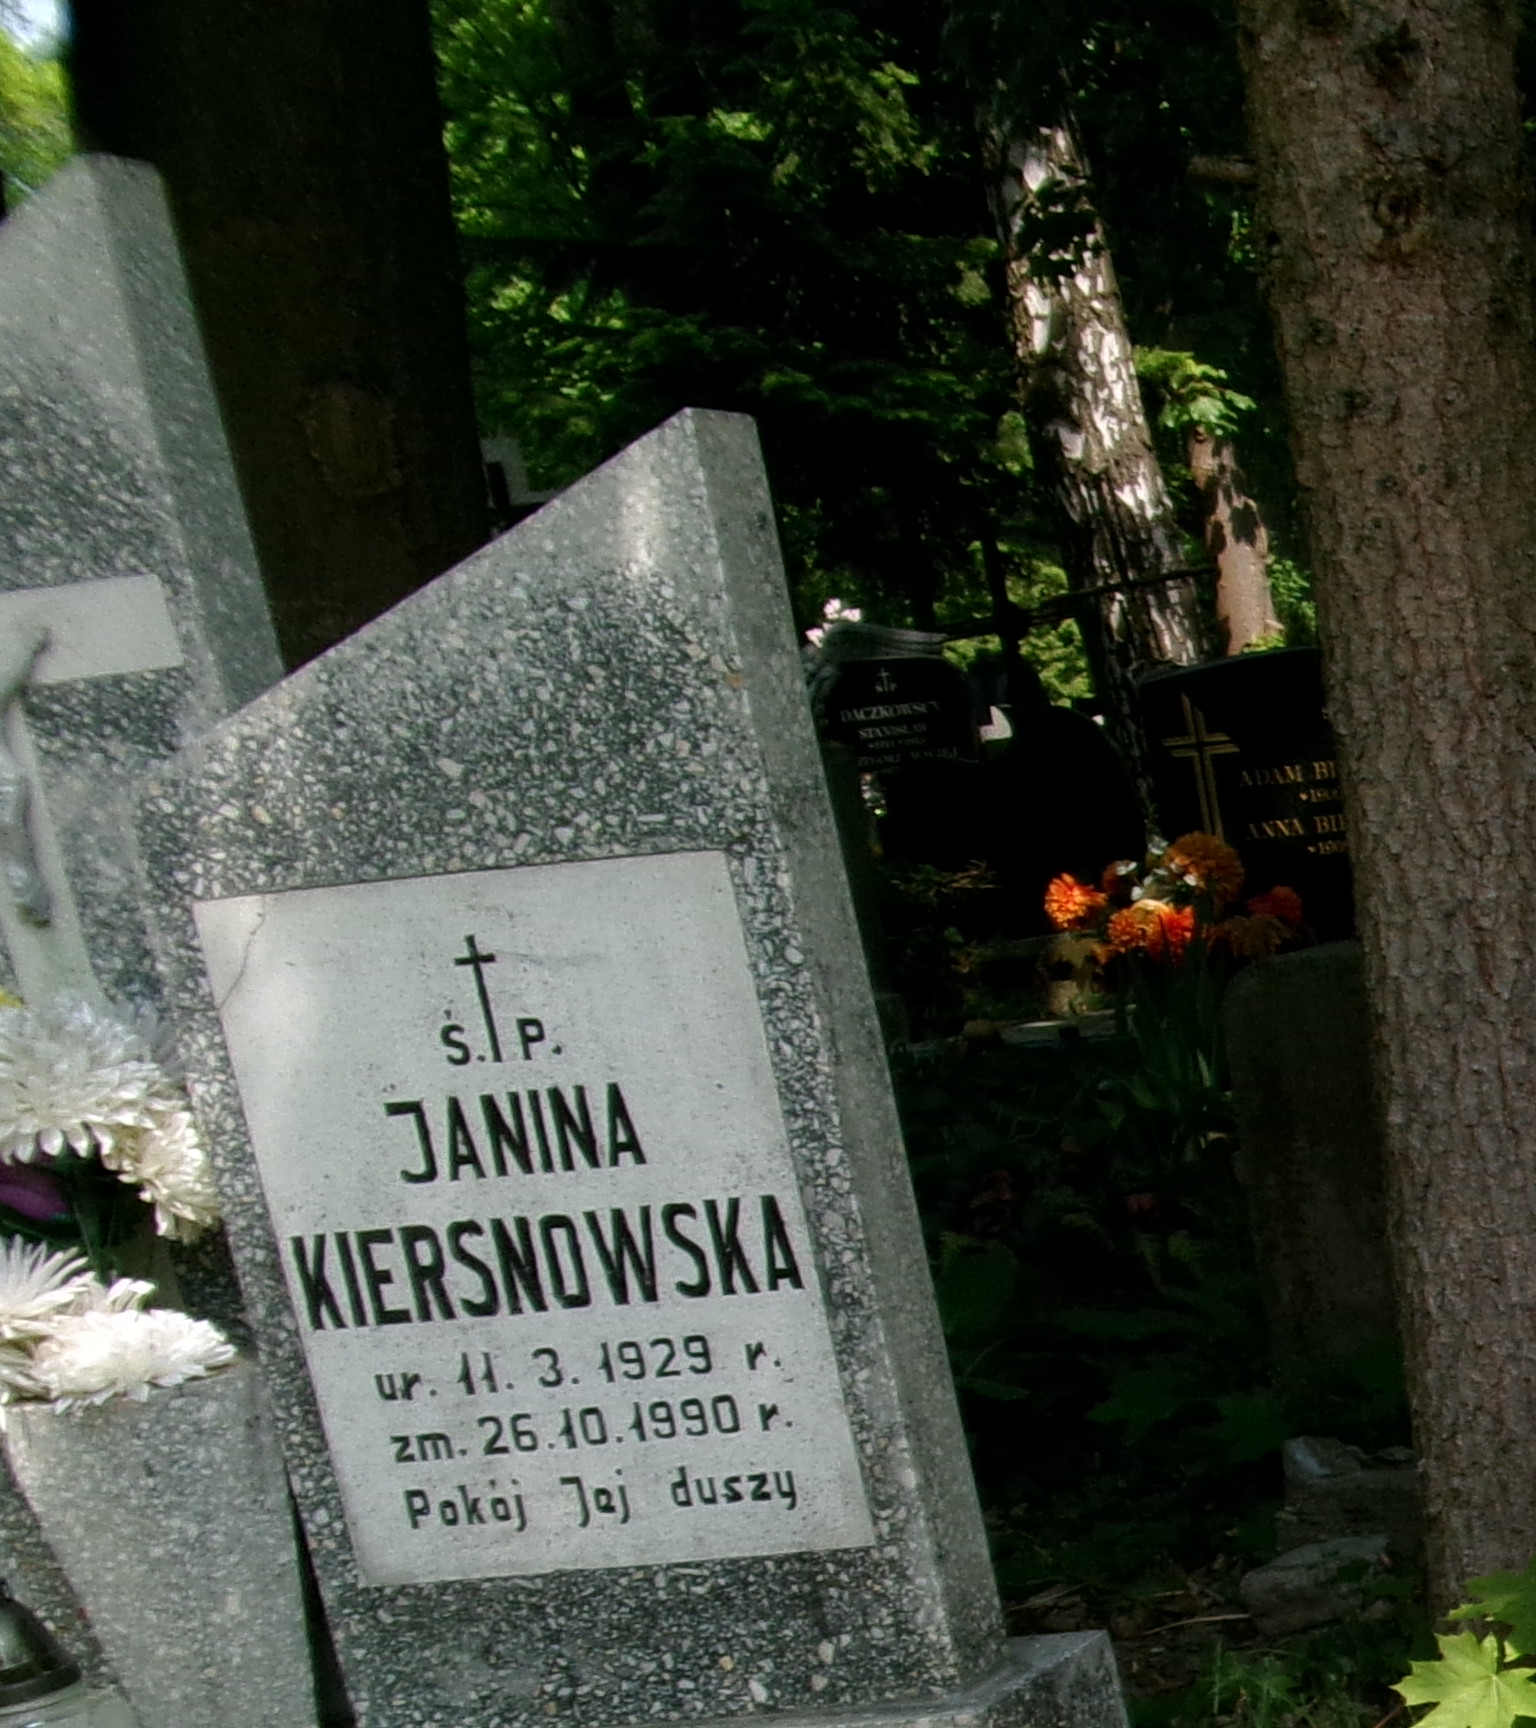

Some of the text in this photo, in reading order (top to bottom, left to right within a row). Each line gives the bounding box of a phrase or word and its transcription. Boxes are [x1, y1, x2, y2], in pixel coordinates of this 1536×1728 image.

[1240, 764, 1304, 787] ADAM
[1246, 818, 1306, 840] ANNA
[385, 1081, 648, 1185] JANINA
[289, 1193, 805, 1331] KIERSNOWSKA
[375, 1371, 438, 1401] ur.
[532, 1346, 581, 1388] 3.
[598, 1333, 713, 1384] 1929
[744, 1341, 784, 1371] r.
[389, 1431, 470, 1463] zm.
[758, 1402, 795, 1432] r.
[559, 1466, 631, 1528] Jej
[670, 1464, 799, 1511] duszy
